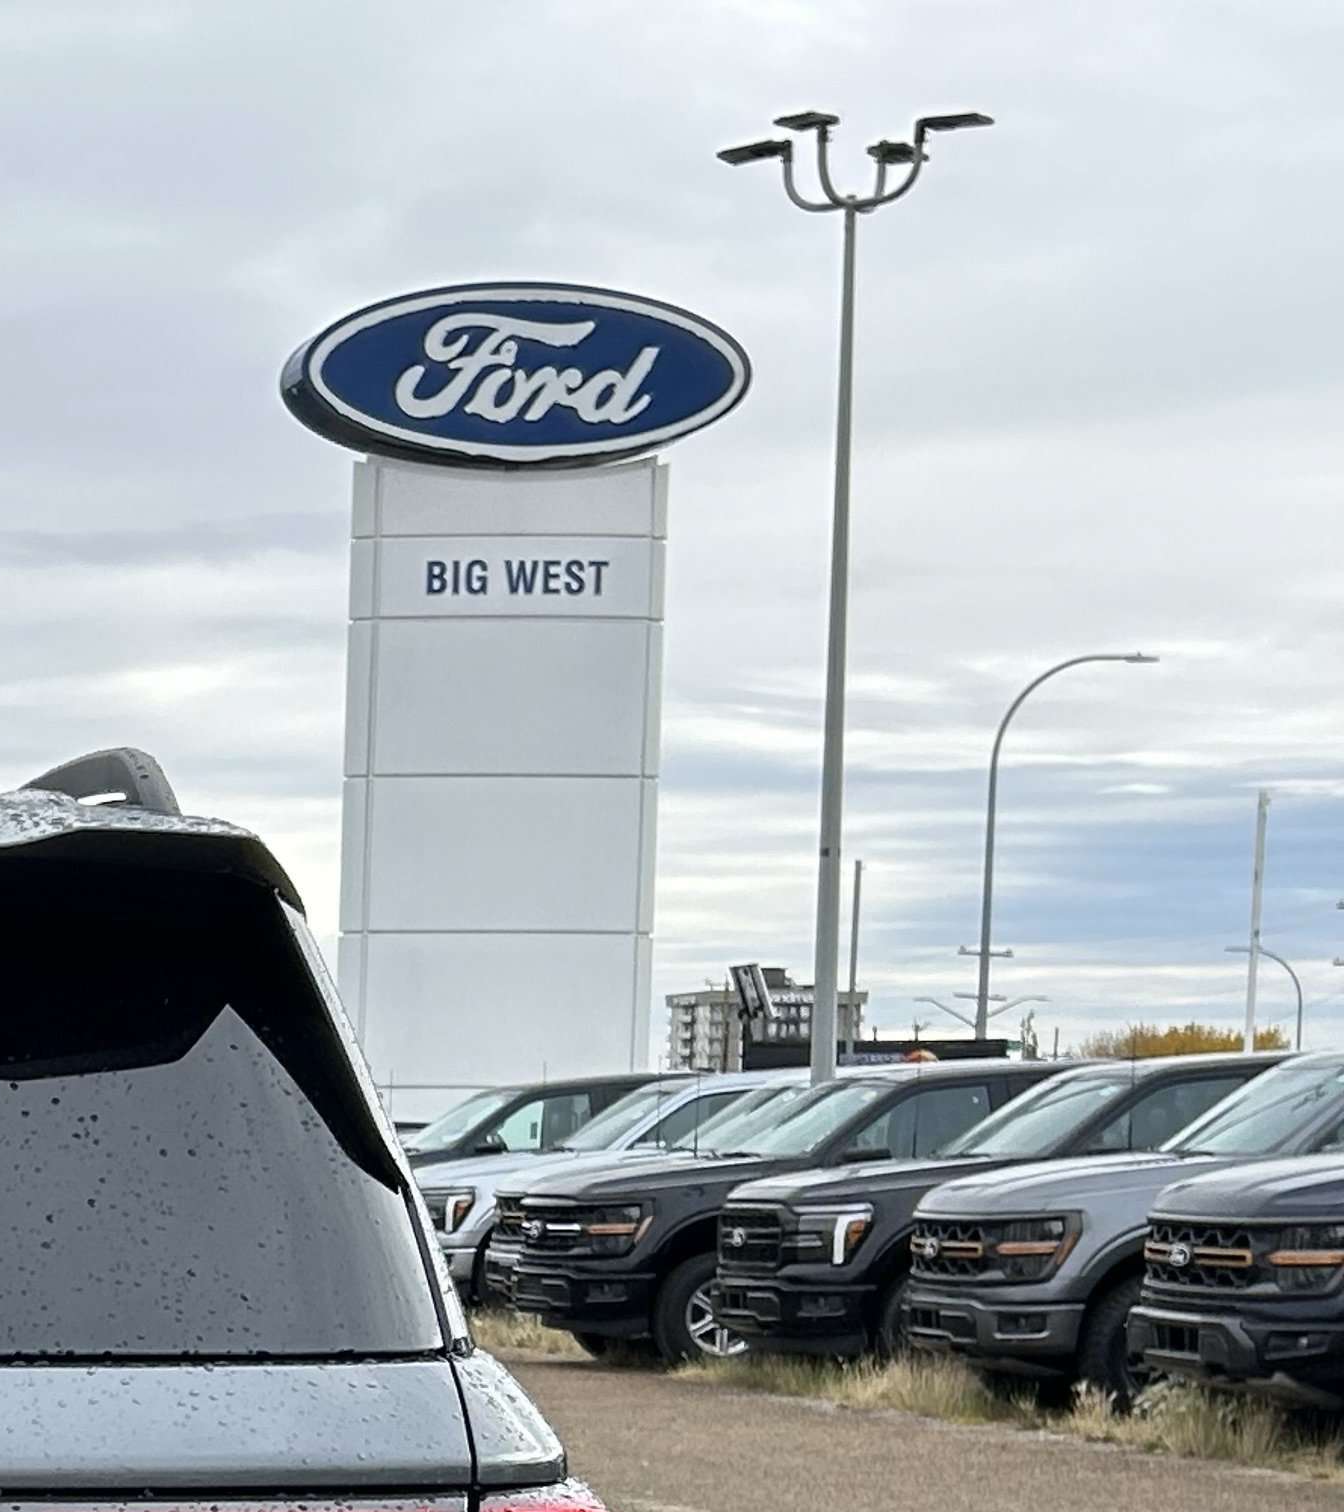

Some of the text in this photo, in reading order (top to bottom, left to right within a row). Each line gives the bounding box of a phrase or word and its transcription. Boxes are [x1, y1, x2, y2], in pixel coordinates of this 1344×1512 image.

[394, 312, 661, 424] Ford
[425, 559, 610, 597] BIG WEST
